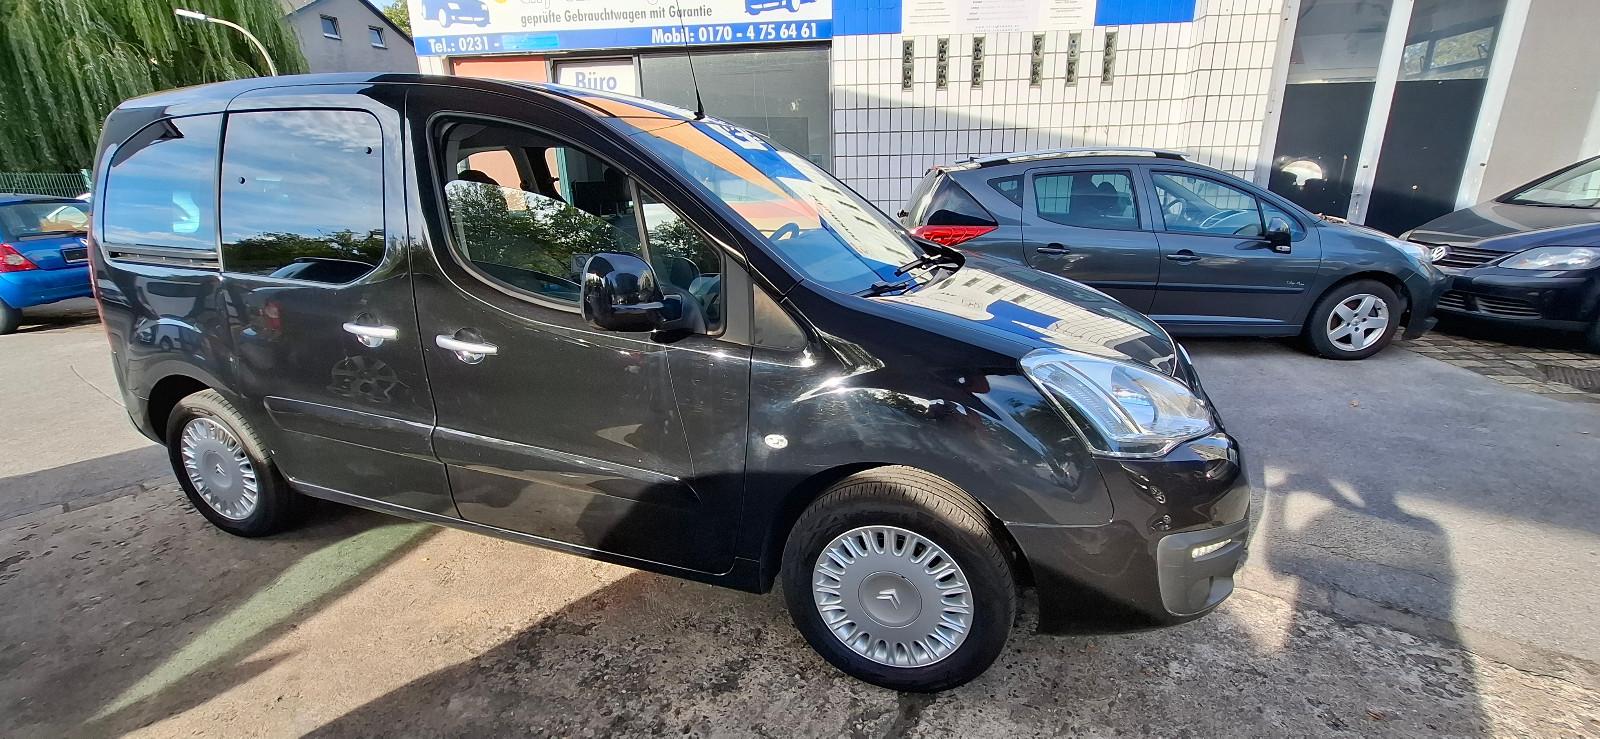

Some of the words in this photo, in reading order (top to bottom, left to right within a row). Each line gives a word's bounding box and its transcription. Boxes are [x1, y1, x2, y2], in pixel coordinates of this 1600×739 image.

[521, 10, 561, 27] geprüfte
[564, 8, 646, 23] Gebrauchtwagen
[650, 6, 665, 19] mit
[669, 5, 713, 18] Garantie
[652, 28, 694, 44] Mobil:
[699, 26, 732, 42] 0170
[746, 24, 755, 39] 4
[759, 24, 775, 39] 75
[780, 23, 797, 39] 64
[801, 22, 816, 38] 61
[429, 38, 455, 53] Tel.:
[459, 35, 488, 52] 0231
[576, 72, 617, 91] Büro
